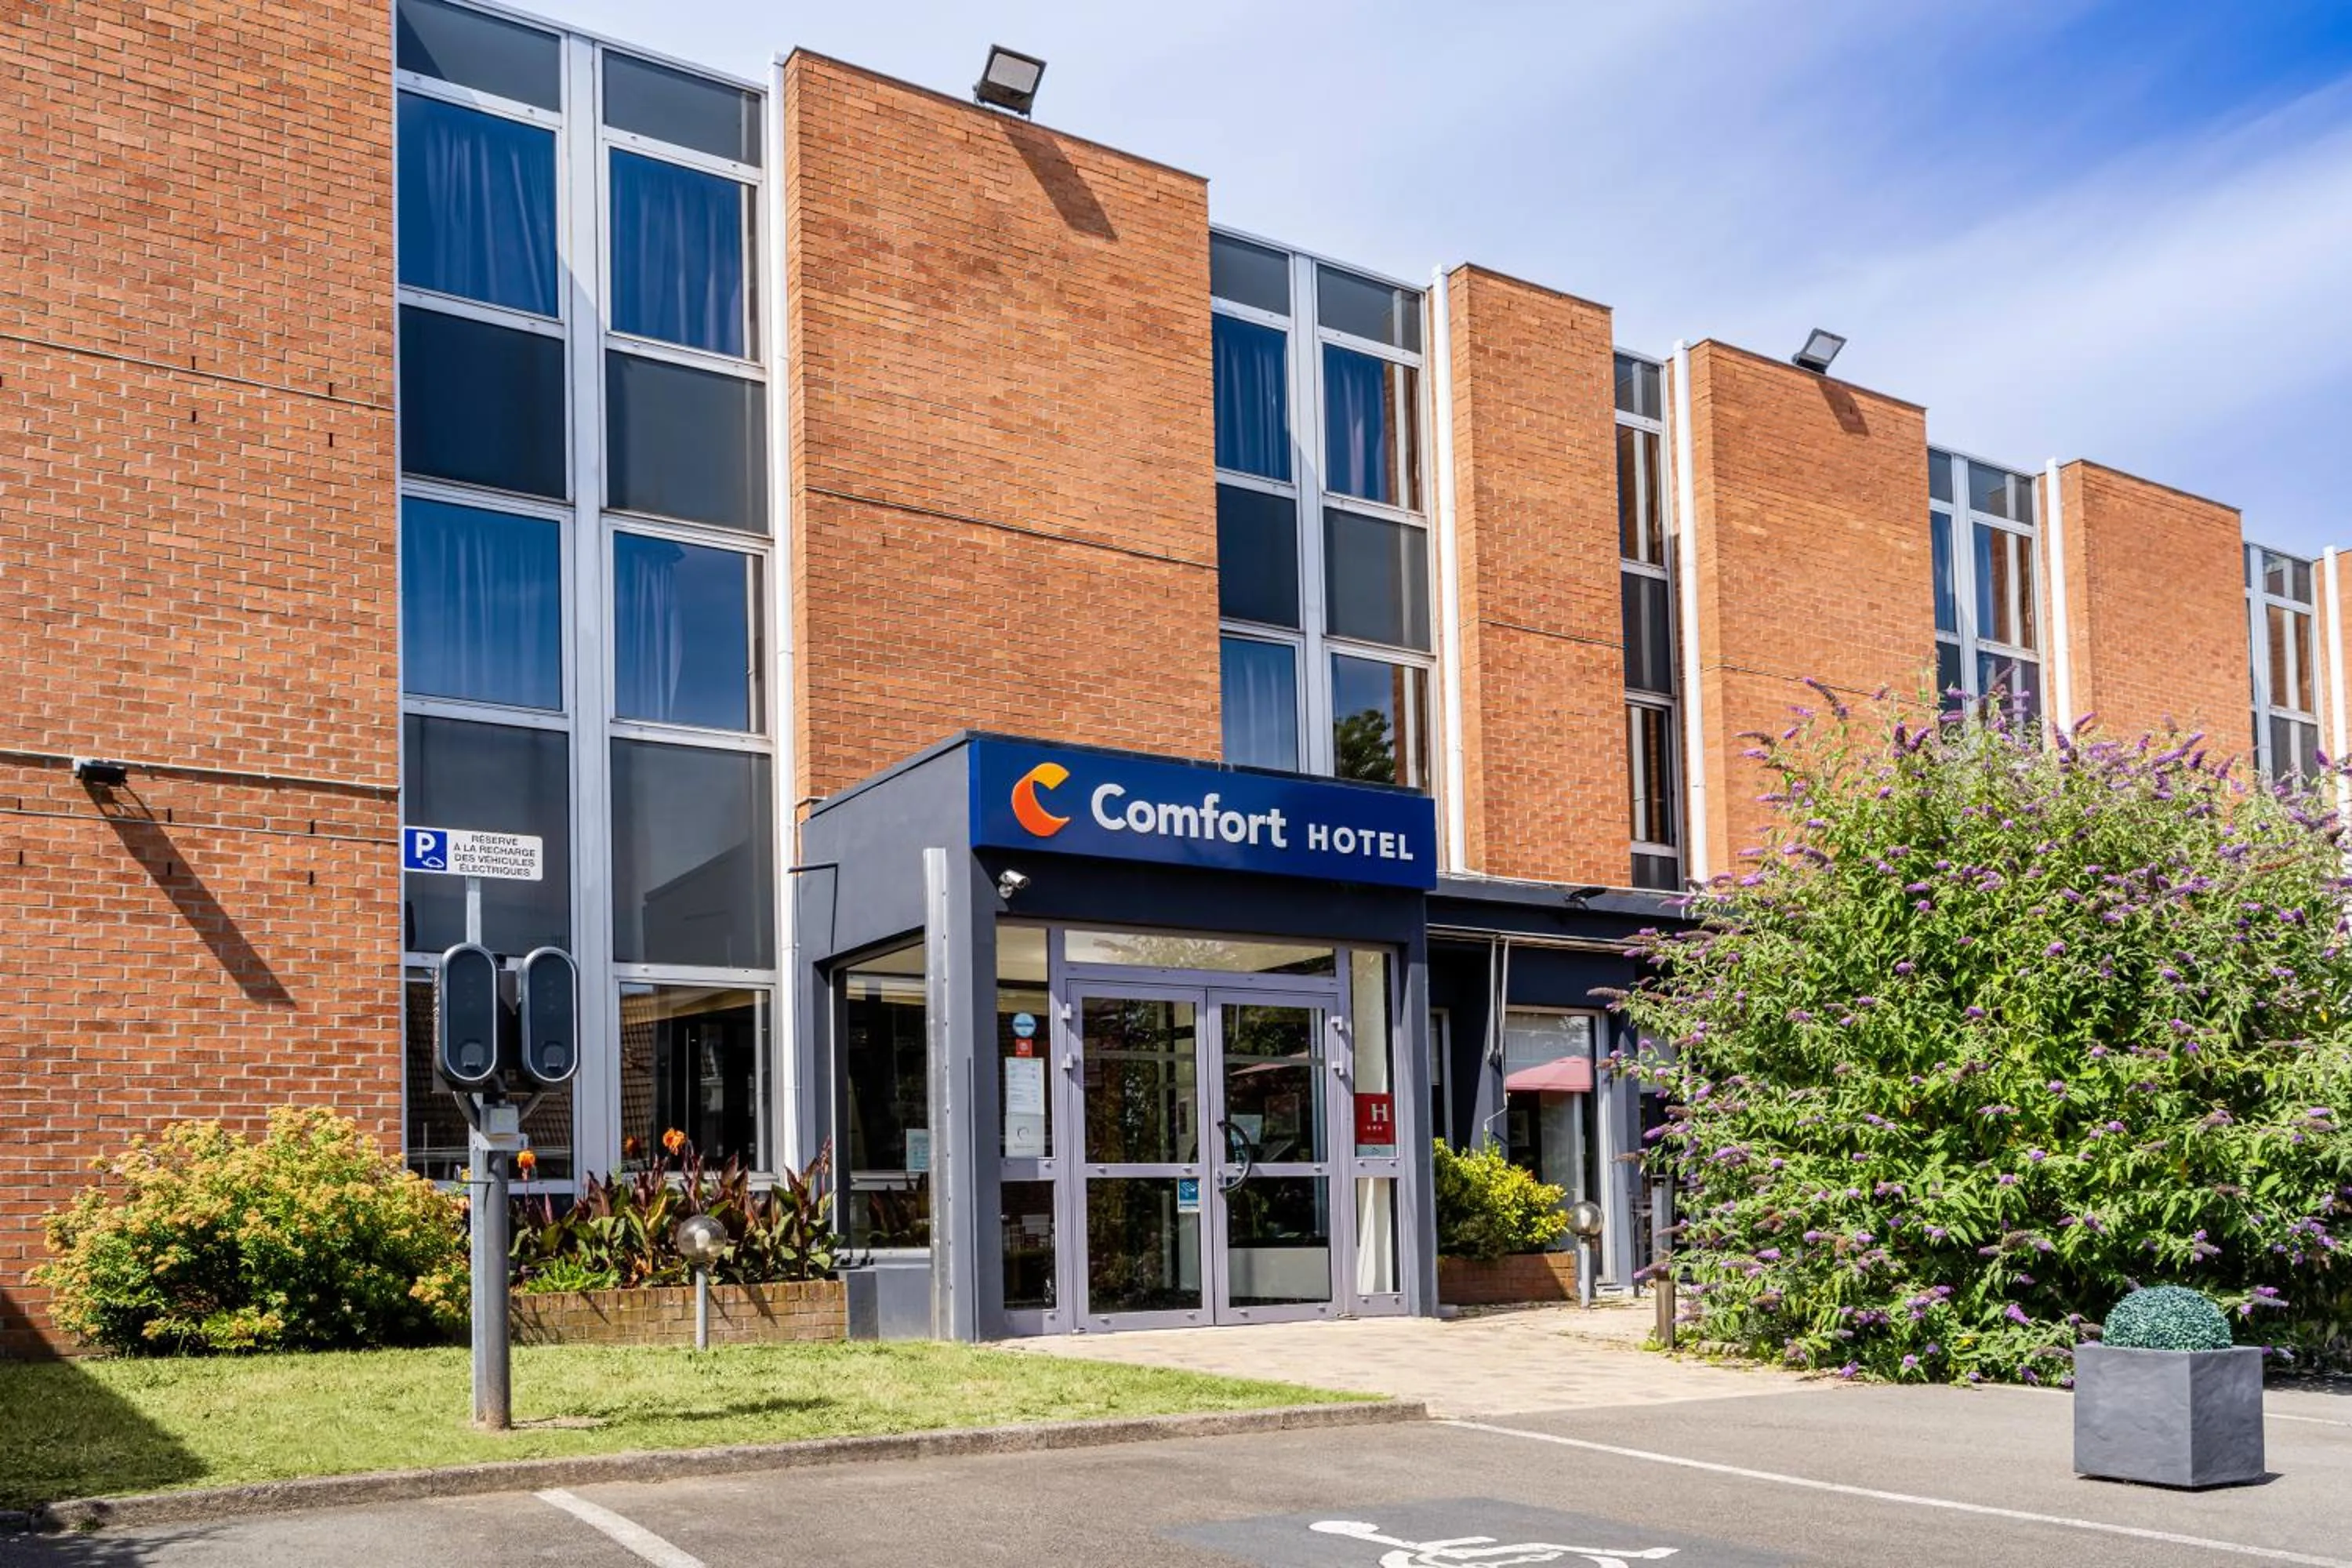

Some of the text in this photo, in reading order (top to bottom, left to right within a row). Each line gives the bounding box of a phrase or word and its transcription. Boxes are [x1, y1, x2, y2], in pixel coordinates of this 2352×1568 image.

[1091, 784, 1287, 848] Comfort
[1308, 824, 1414, 860] HOTEL
[416, 833, 437, 858] P
[480, 845, 535, 857] RECHARGE
[454, 853, 475, 862] DES
[1371, 1104, 1388, 1121] H
